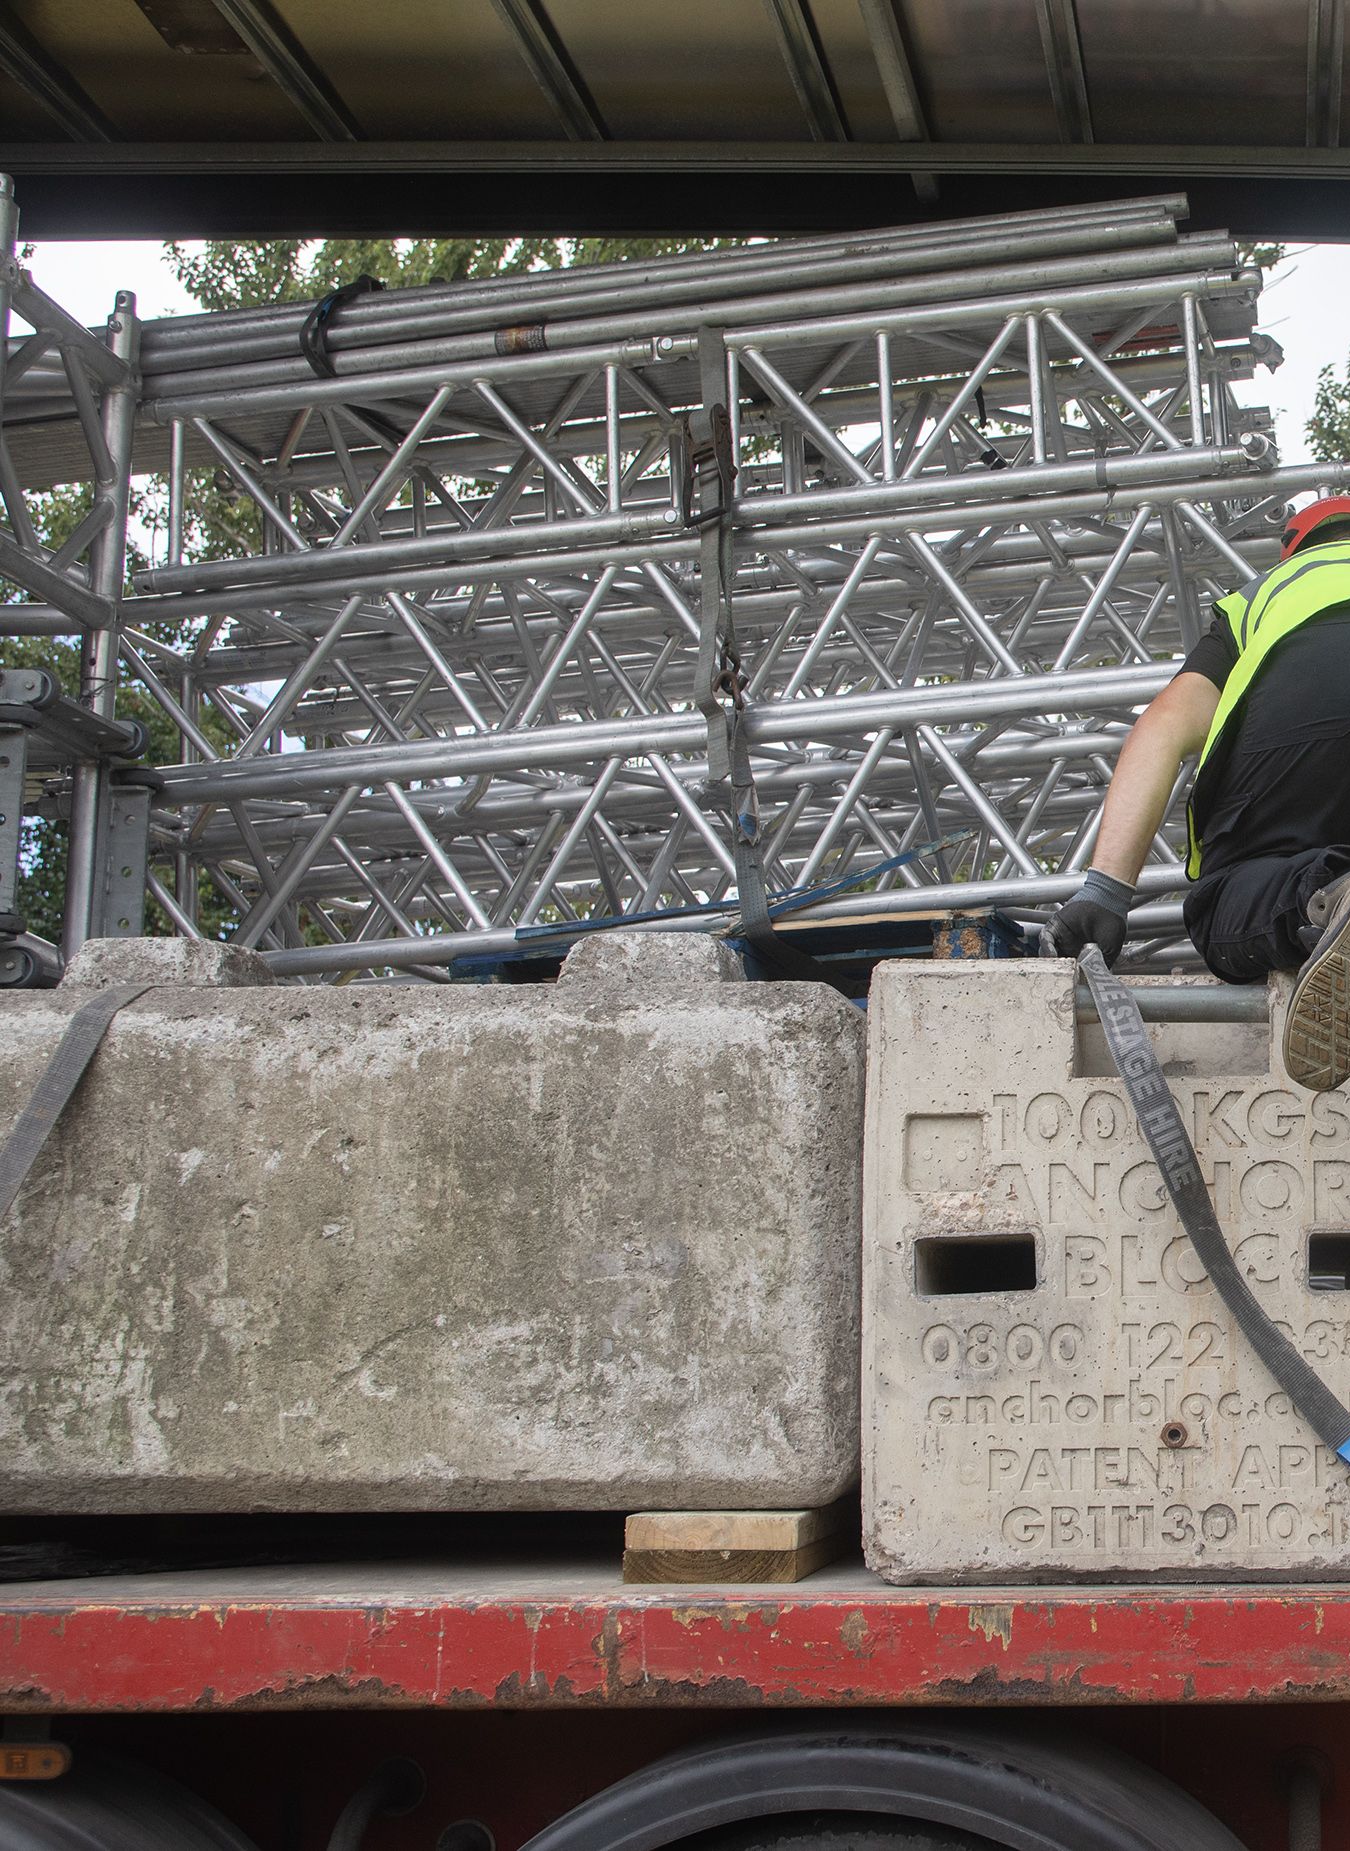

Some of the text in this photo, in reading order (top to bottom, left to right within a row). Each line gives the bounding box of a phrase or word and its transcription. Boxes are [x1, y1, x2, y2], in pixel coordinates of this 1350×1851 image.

[1106, 1004, 1163, 1101] STAGE
[1144, 1103, 1198, 1193] HIRE
[1065, 1232, 1281, 1299] BLOC
[921, 1322, 1087, 1371] 0800
[1121, 1321, 1225, 1370] 122
[988, 1446, 1202, 1491] PATENT
[1001, 1501, 1346, 1550] GB1113010.1
